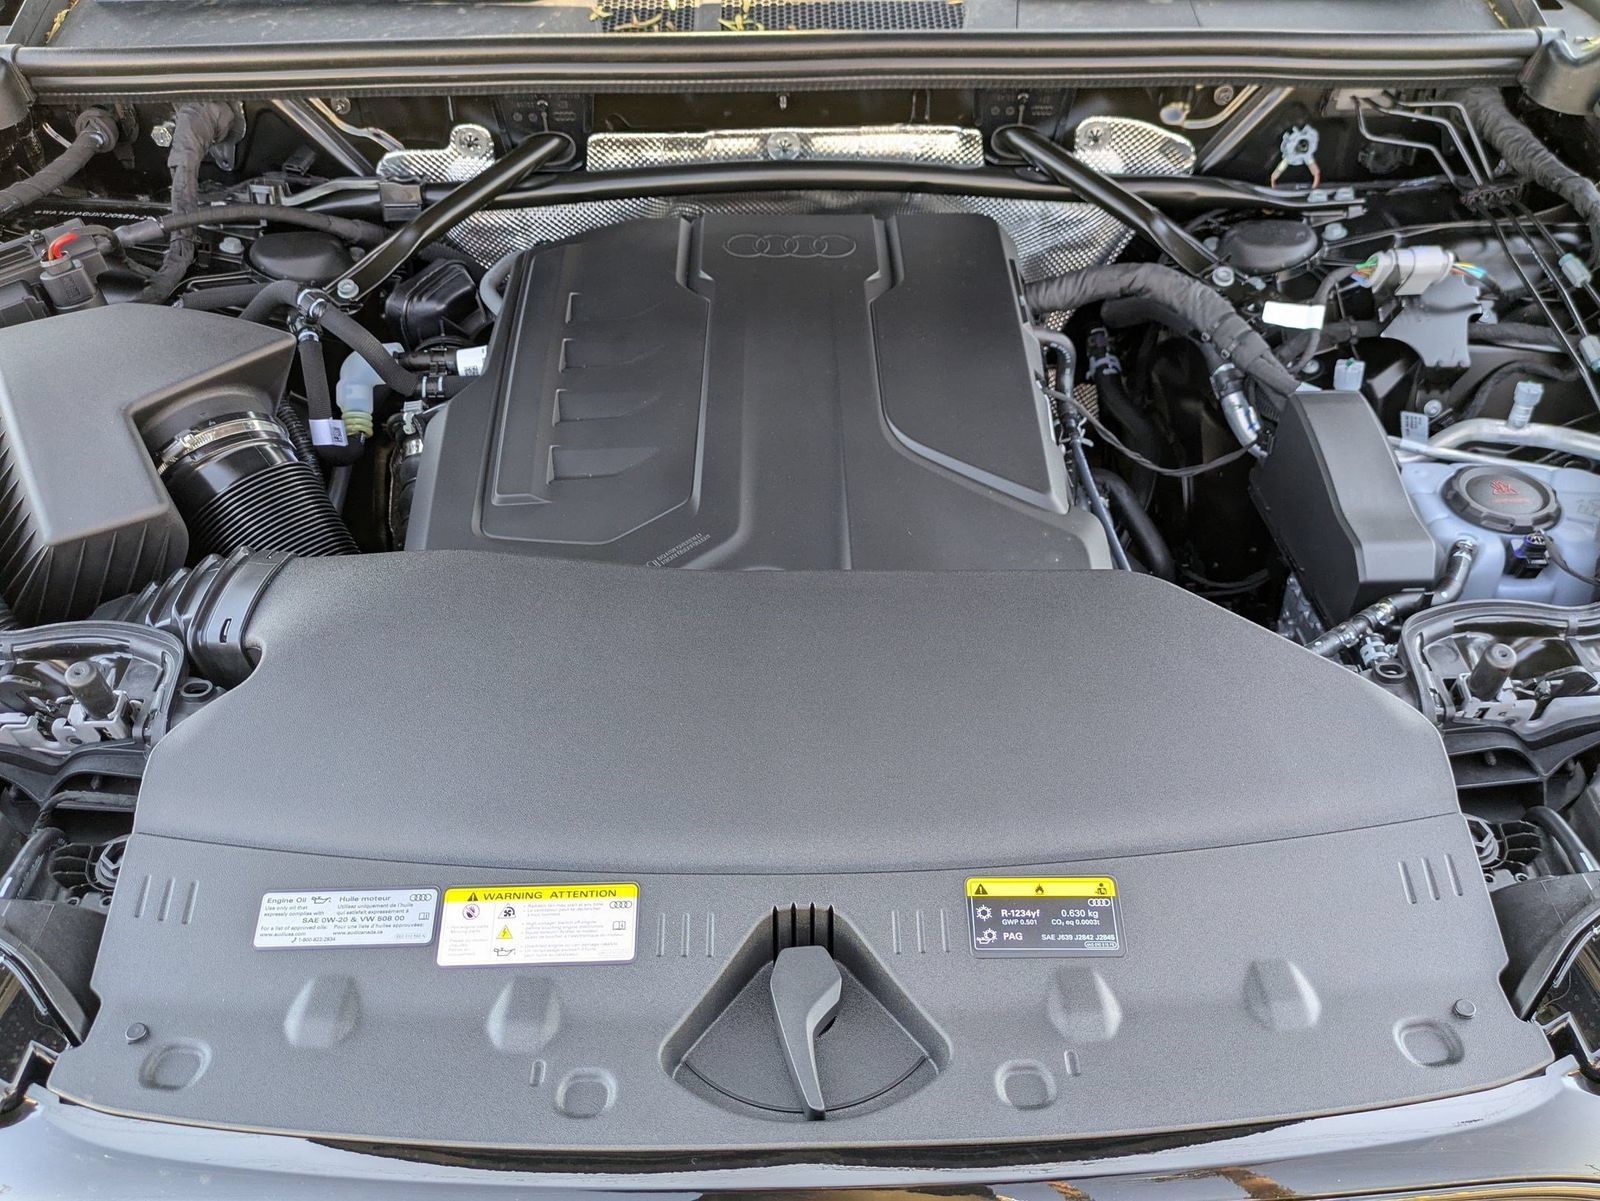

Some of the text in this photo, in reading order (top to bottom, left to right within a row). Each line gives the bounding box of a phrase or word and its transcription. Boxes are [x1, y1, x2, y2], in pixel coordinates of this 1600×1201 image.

[483, 890, 617, 900] WARNING ATTENTION
[1001, 909, 1040, 918] R-1234yf
[1087, 910, 1099, 918] kg
[1003, 933, 1023, 941] PAG
